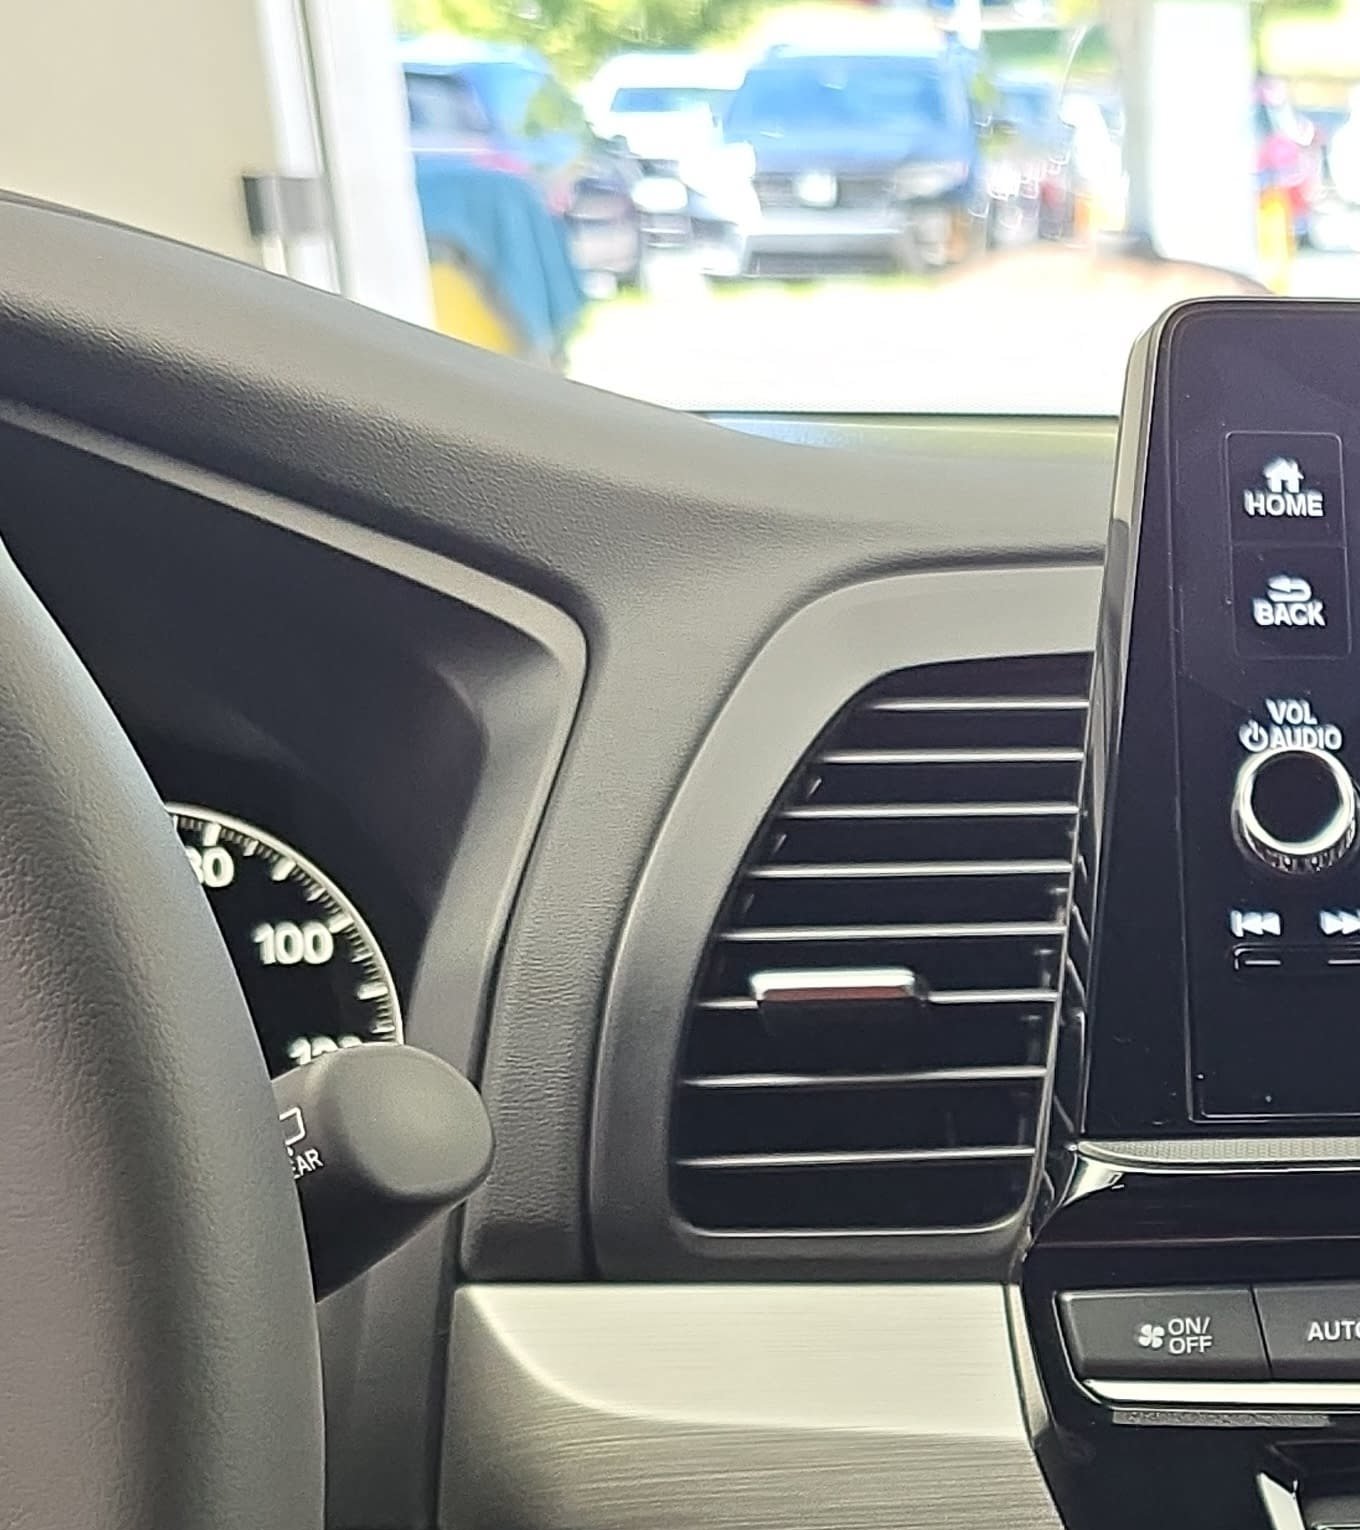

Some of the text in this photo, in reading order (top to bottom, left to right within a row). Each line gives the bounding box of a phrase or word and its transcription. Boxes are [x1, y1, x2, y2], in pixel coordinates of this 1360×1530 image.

[1244, 489, 1325, 518] HOME
[1253, 600, 1326, 628] BACK
[1266, 699, 1317, 726] VOL
[1270, 723, 1343, 750] AUDIO
[254, 921, 334, 965] 100
[1167, 1317, 1211, 1336] ON/
[1169, 1335, 1213, 1355] OFF
